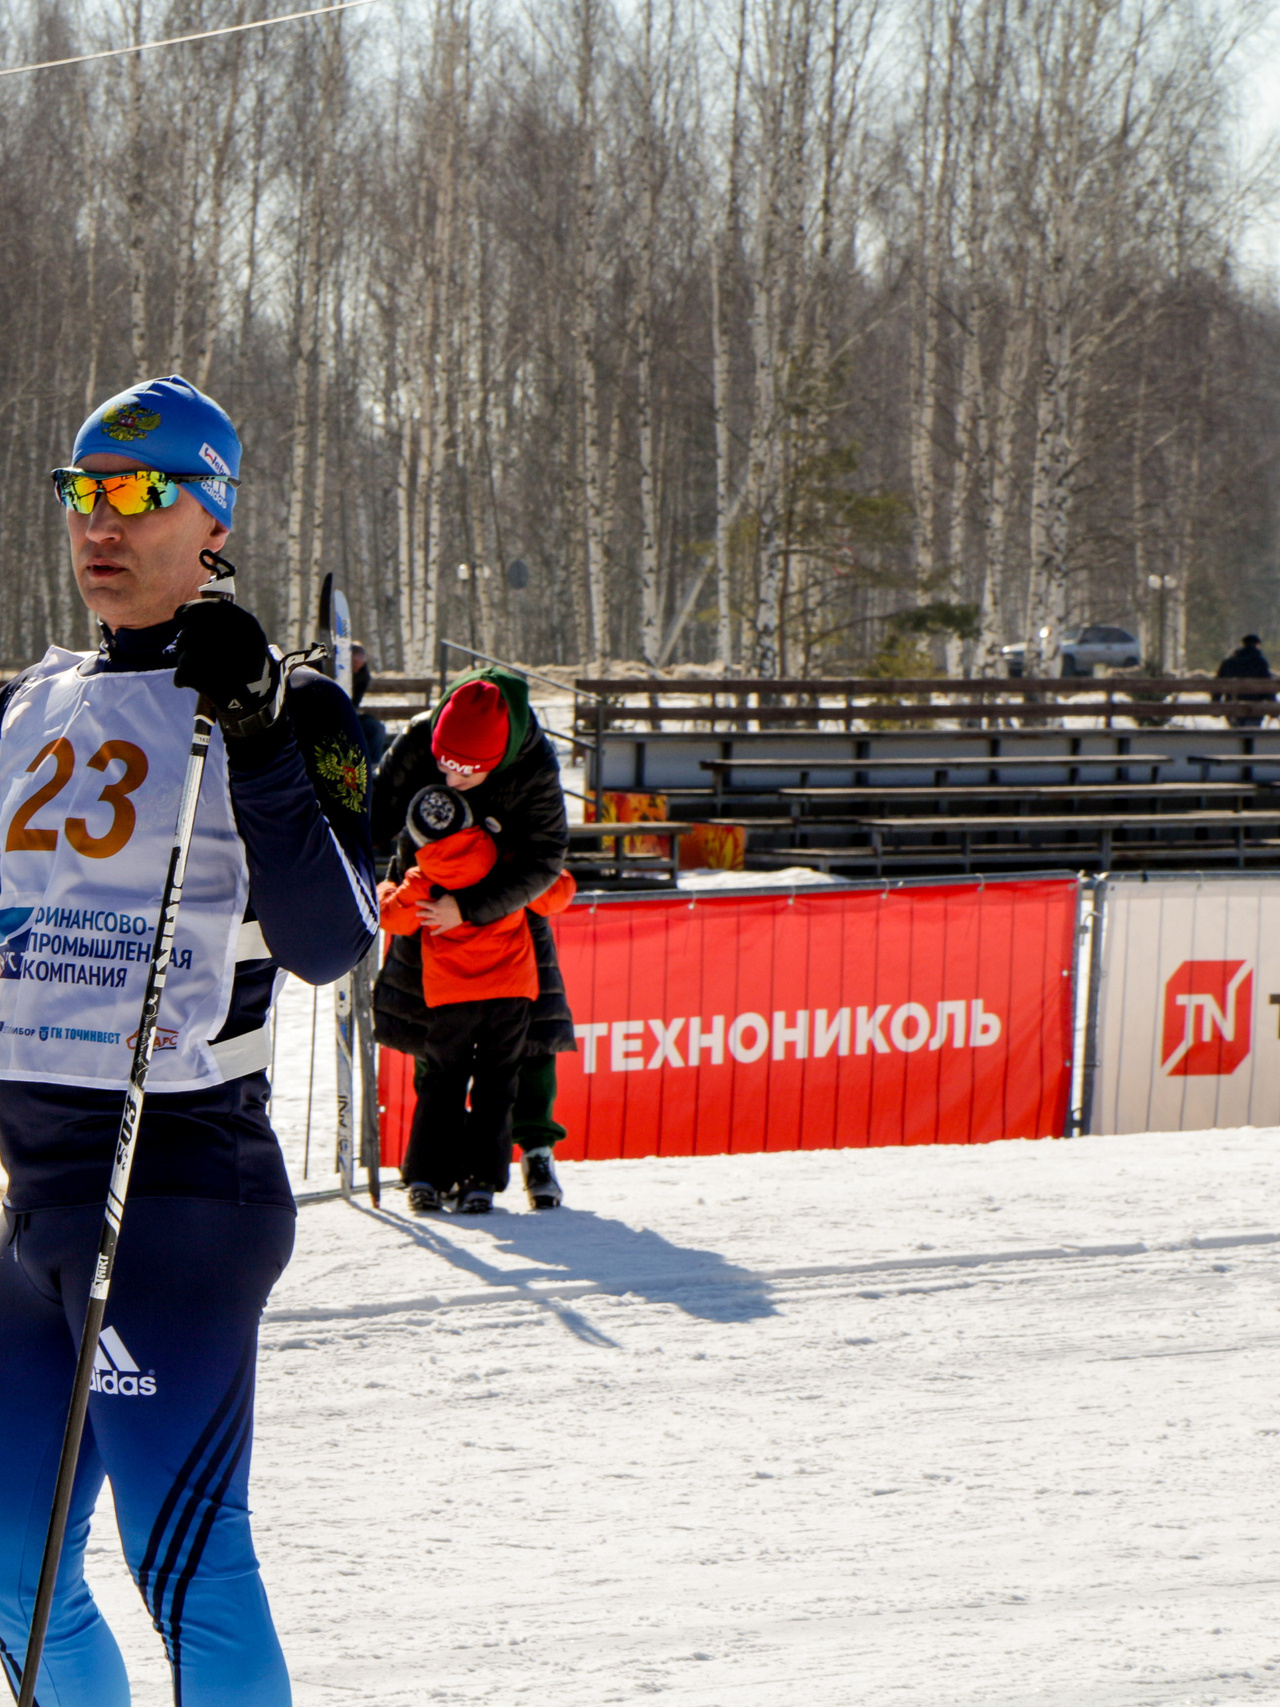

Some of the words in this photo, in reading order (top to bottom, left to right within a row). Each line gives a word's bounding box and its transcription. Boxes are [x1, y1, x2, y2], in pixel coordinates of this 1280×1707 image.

[200, 481, 228, 509] adidas
[440, 754, 474, 775] LOVE
[5, 736, 149, 859] 23
[28, 932, 193, 970] ПРОМЫШЛЕНАЯ
[22, 958, 127, 988] КОМПАНИЯ
[50, 1026, 63, 1039] ГК
[65, 1027, 121, 1044] ТОЧИНВЕСТ
[573, 998, 1002, 1075] ТЕХНОНИКОЛЬ
[89, 1368, 158, 1396] didas
